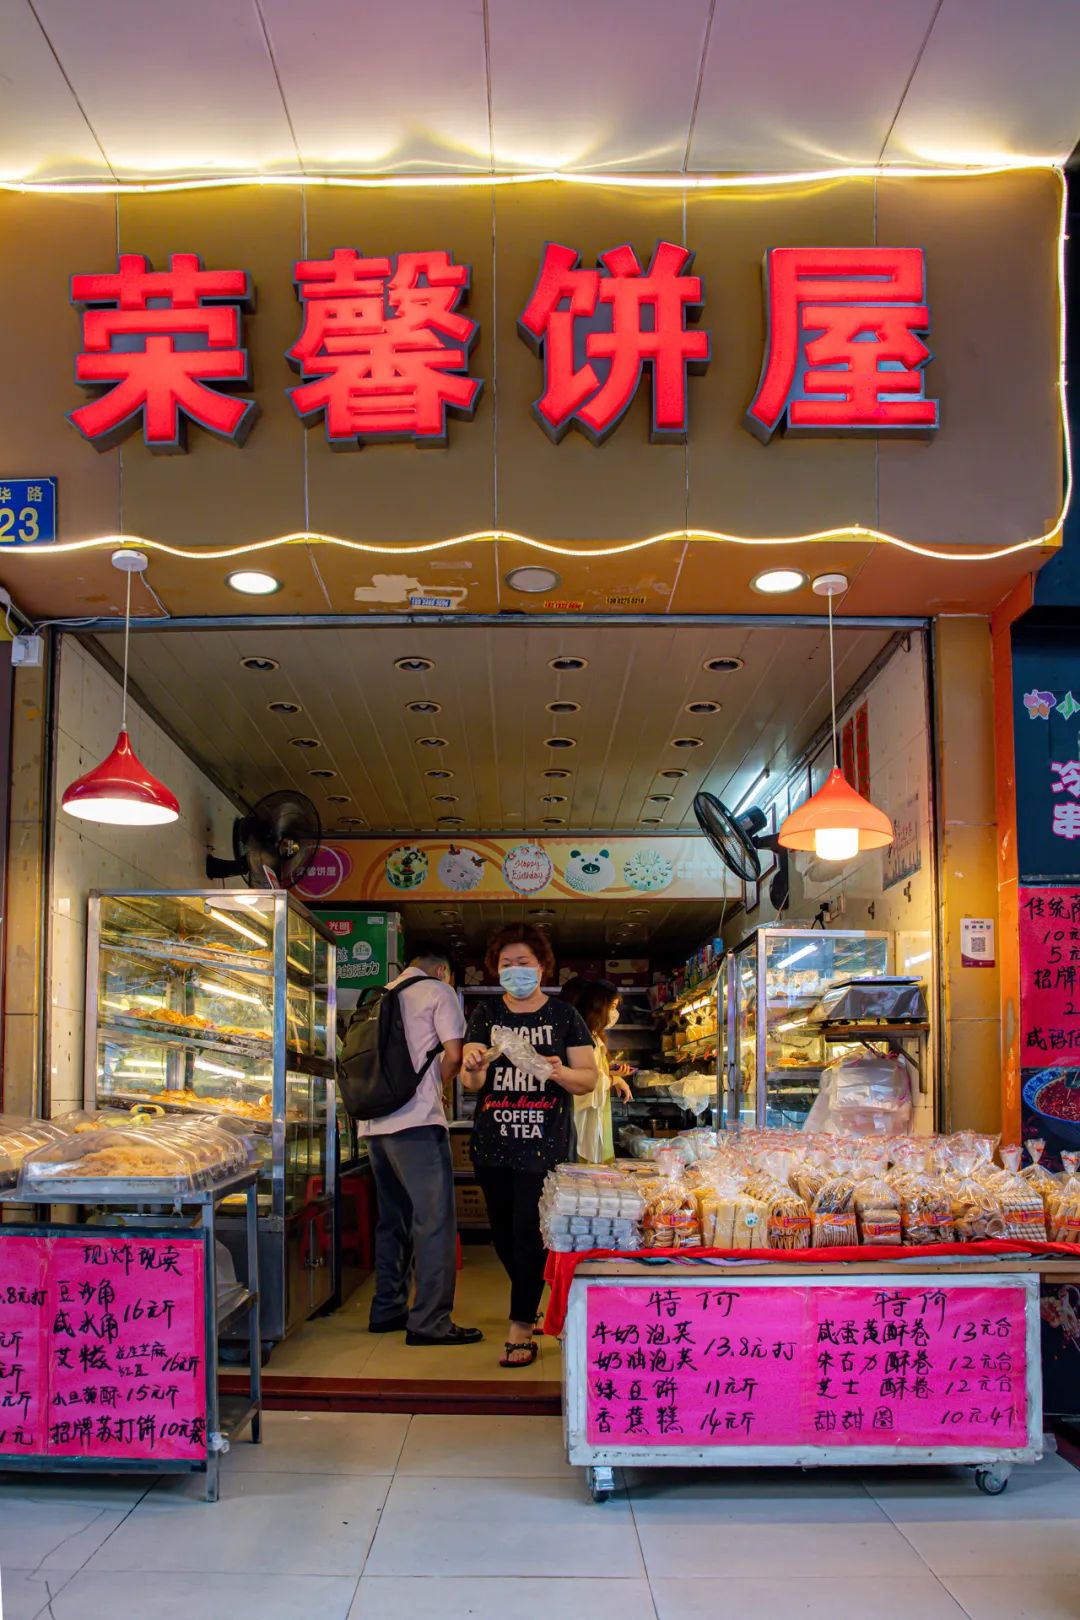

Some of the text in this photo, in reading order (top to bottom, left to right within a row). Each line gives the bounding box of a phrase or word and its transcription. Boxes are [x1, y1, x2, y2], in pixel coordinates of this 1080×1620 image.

[68, 240, 940, 448] 荣馨饼屋
[491, 1025, 553, 1046] GHT
[500, 1124, 543, 1138] & TEA
[0, 1287, 47, 1306] .8元打
[592, 1321, 696, 1345] 牛奶泡芙
[592, 1347, 698, 1372] 奶油泡芙
[595, 1377, 678, 1406] 绿豆饼
